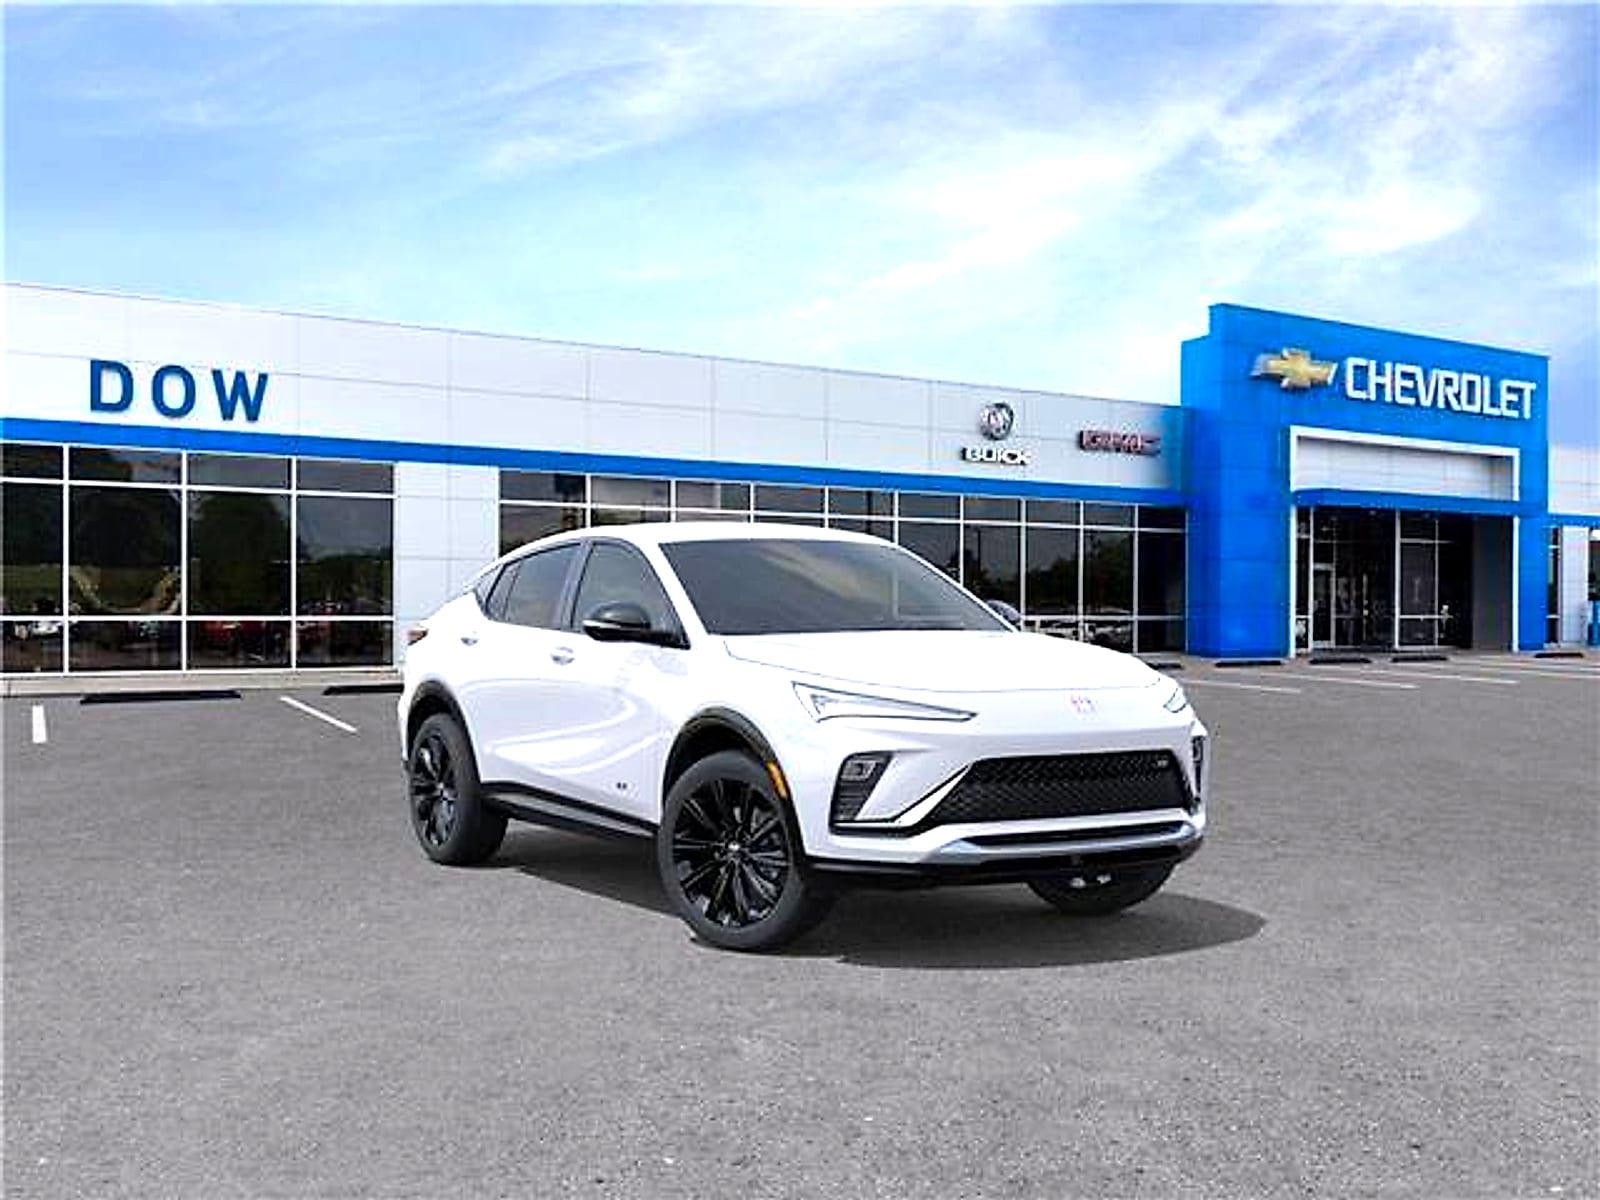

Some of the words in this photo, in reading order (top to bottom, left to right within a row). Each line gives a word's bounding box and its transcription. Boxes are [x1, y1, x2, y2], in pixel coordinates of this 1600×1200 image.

[90, 359, 268, 422] DOW
[1345, 357, 1537, 419] CHEVROLET
[962, 448, 1030, 465] BUICK
